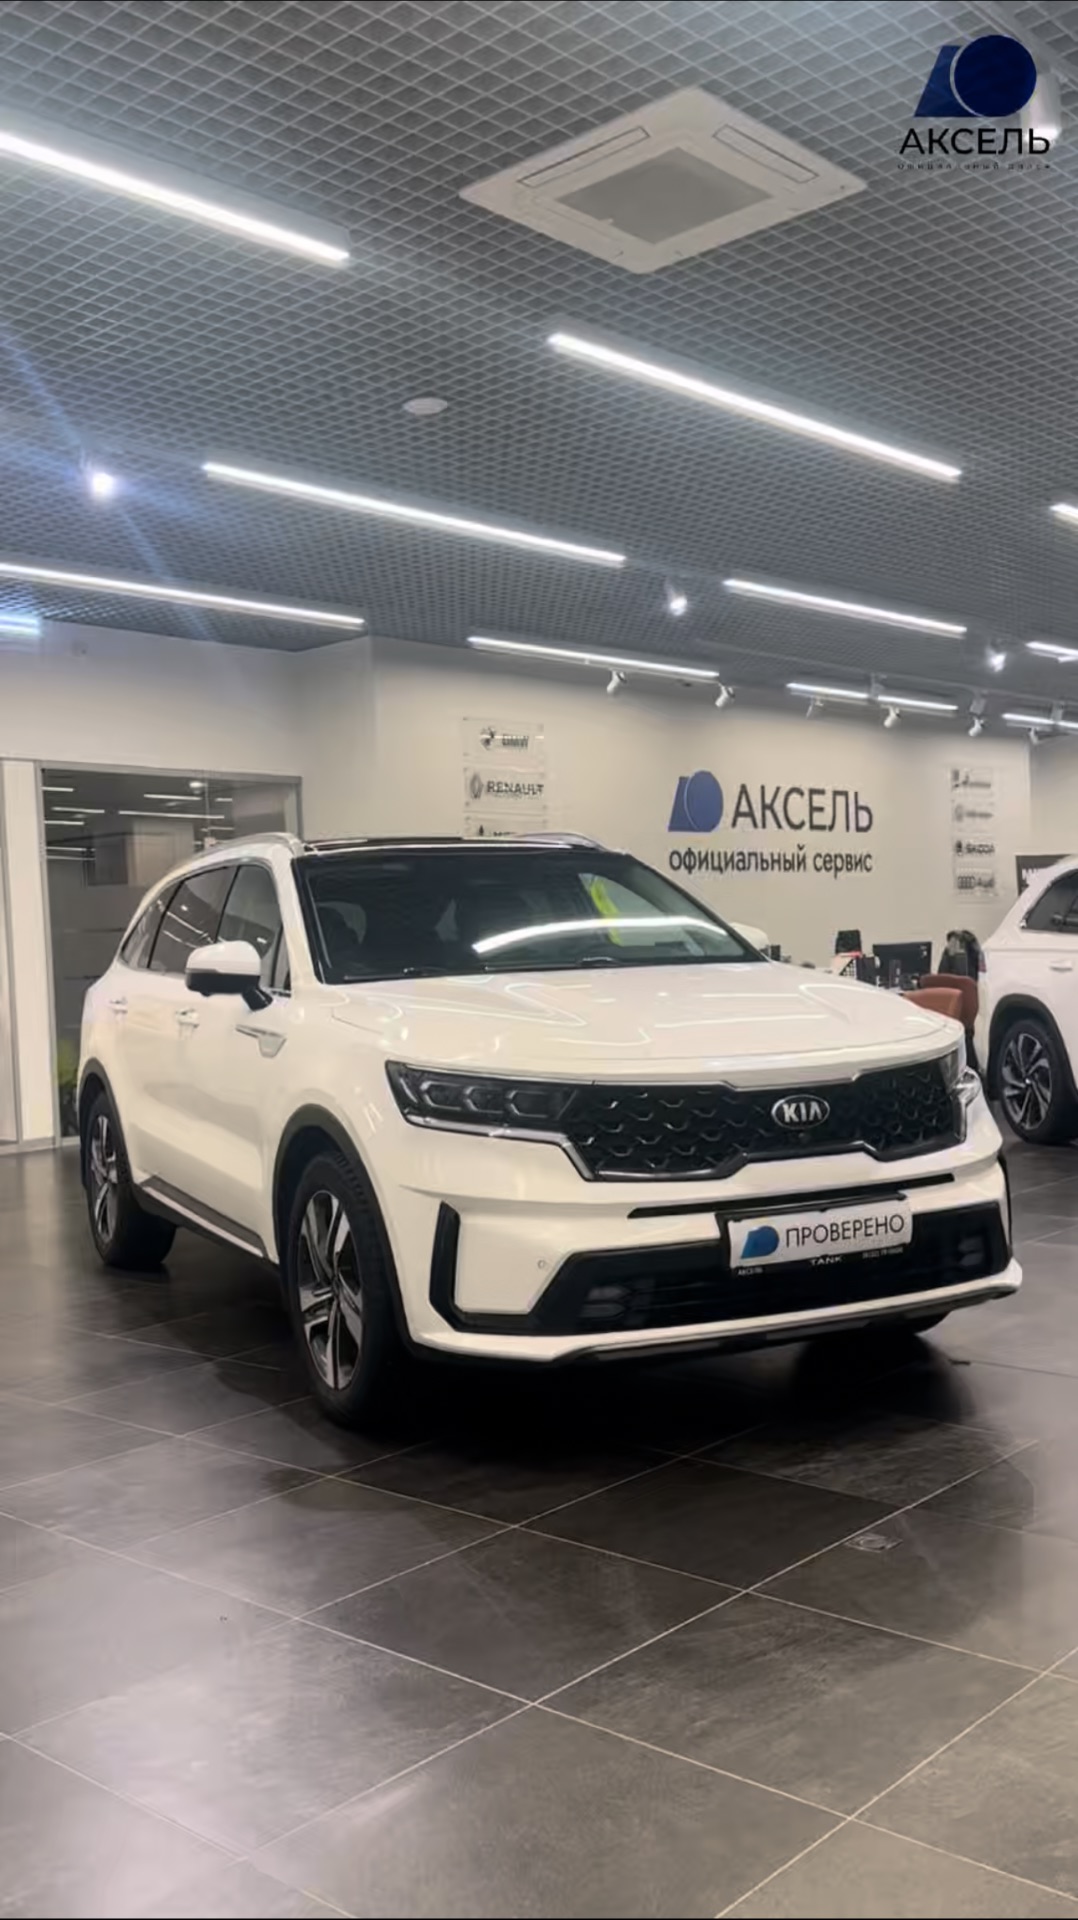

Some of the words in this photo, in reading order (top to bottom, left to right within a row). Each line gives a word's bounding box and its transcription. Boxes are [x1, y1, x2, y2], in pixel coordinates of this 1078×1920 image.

[487, 781, 544, 796] RENAULT
[731, 783, 873, 833] АКСЕЛЬ
[669, 844, 807, 875] официальный
[813, 853, 873, 879] сервис
[782, 1101, 822, 1123] KIA
[786, 1214, 905, 1248] ПРОВЕРЕНО
[811, 1256, 842, 1266] TANK
